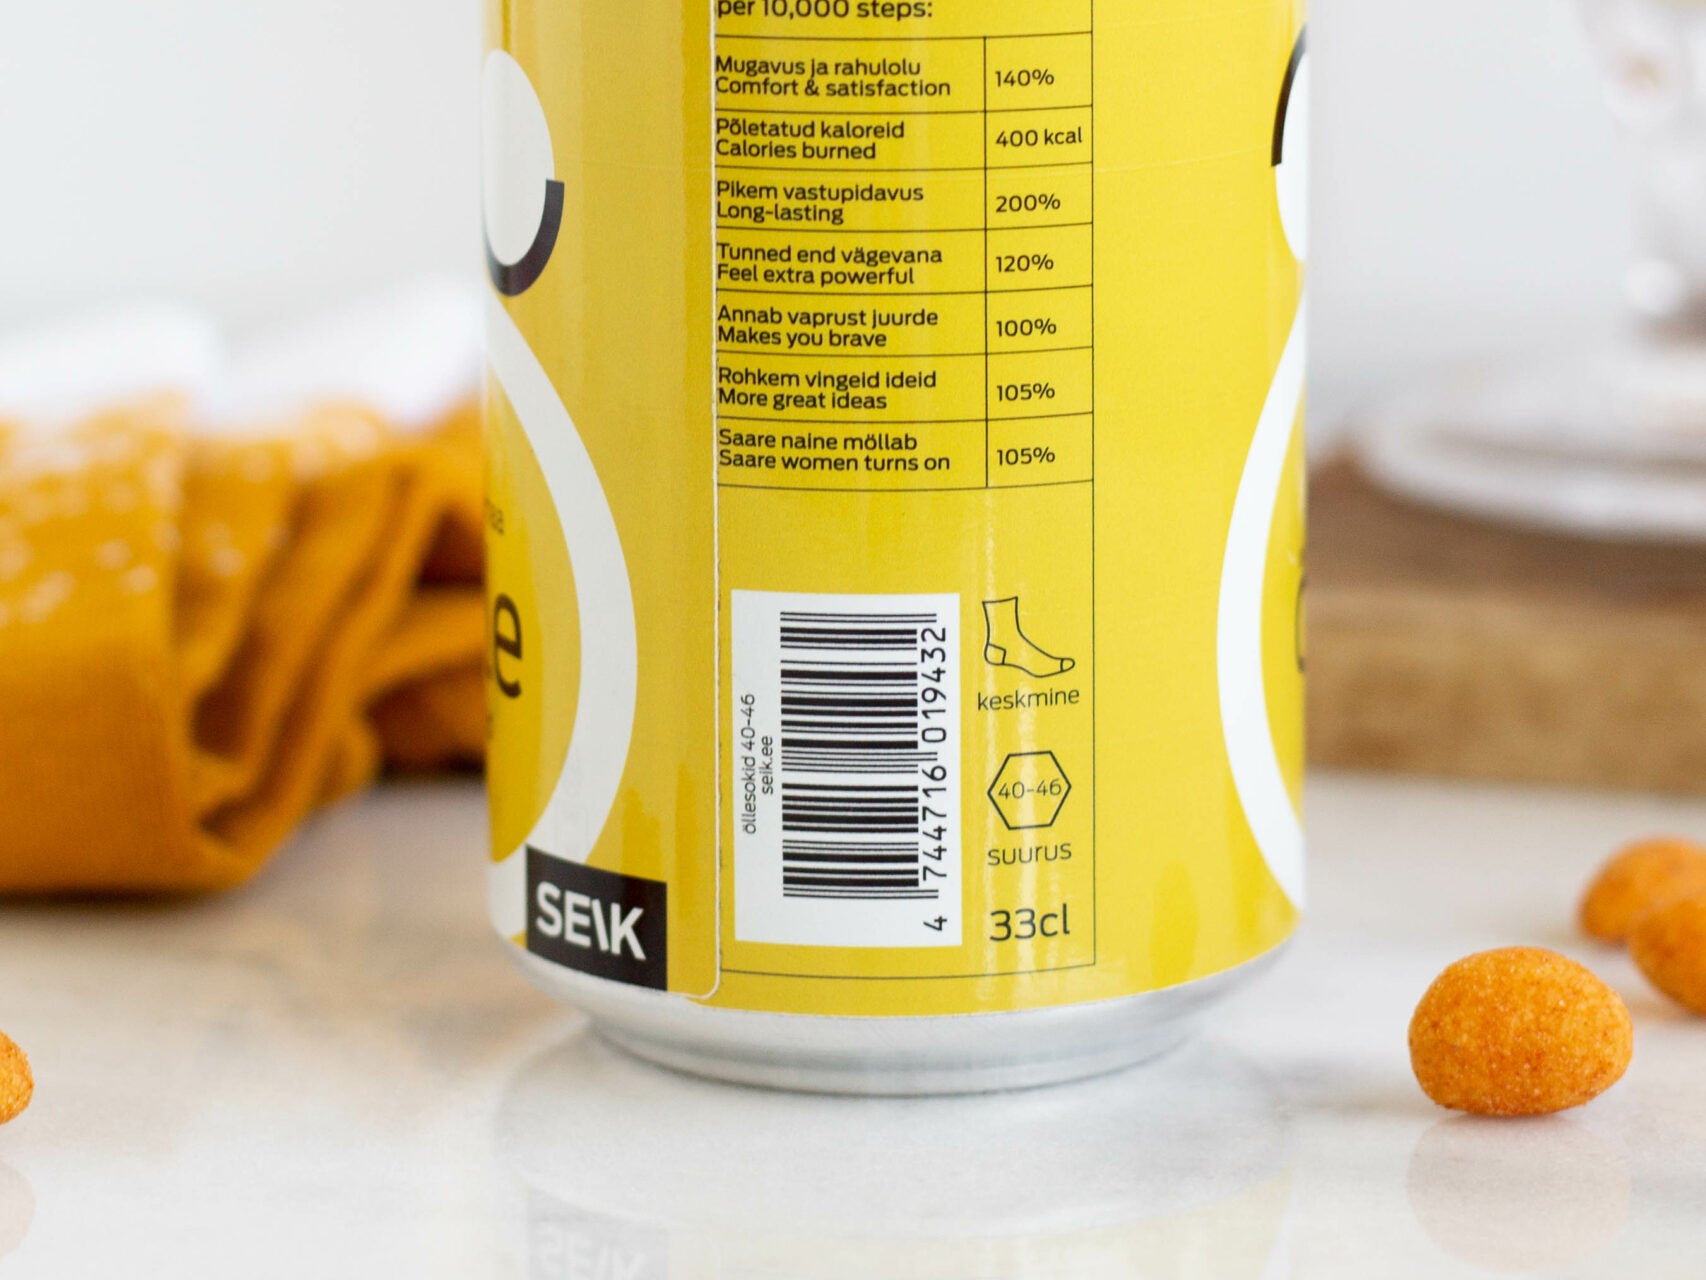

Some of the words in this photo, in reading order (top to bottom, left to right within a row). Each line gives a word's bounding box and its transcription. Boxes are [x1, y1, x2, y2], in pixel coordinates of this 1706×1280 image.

[716, 56, 805, 78] Mugavus
[811, 59, 829, 78] ja
[835, 59, 920, 75] rahulolu
[995, 69, 1054, 87] 140%
[716, 76, 798, 95] Comfort
[805, 80, 819, 96] &
[826, 78, 950, 97] satisfaction
[716, 119, 815, 138] Põletatud
[821, 121, 904, 139] kaloreid
[996, 130, 1038, 147] 400
[1044, 127, 1082, 145] kcal
[716, 139, 797, 158] Calories
[803, 141, 876, 160] burned
[718, 181, 777, 199] Pikem
[784, 184, 923, 203] vastupidavus
[718, 202, 843, 224] Long-lasting
[996, 194, 1060, 213] 200%
[718, 243, 791, 262] Tunned
[798, 246, 835, 263] end
[842, 247, 942, 267] vägevana
[996, 254, 1054, 273] 120%
[718, 264, 758, 281] Feel
[763, 268, 814, 283] extra
[822, 268, 914, 287] powerful
[719, 305, 782, 325] Annab
[788, 310, 866, 329] vaprust
[872, 308, 938, 328] juurde
[996, 318, 1057, 337] 100%
[719, 326, 781, 346] Makes
[787, 333, 823, 348] you
[829, 330, 887, 347] brave
[720, 367, 799, 387] Rohkem
[805, 372, 880, 391] vingeid
[886, 371, 936, 388] ideid
[719, 388, 767, 406] More
[773, 392, 825, 410] great
[831, 391, 887, 409] ideas
[996, 382, 1055, 402] 105%
[720, 429, 776, 447] Saare
[782, 433, 838, 449] naine
[844, 434, 917, 451] möllab
[720, 449, 776, 468] Saare
[782, 455, 858, 470] women
[864, 455, 918, 471] turns
[924, 455, 950, 470] on
[997, 447, 1056, 466] 105%
[922, 627, 946, 743] 019432
[978, 687, 1079, 711] keskmine
[740, 693, 755, 751] 40-46
[759, 735, 774, 795] seik.ee
[998, 779, 1062, 800] 40-46
[922, 765, 948, 881] 744716
[988, 843, 1072, 866] suurus
[924, 916, 948, 931] 4
[990, 903, 1070, 941] 33cl
